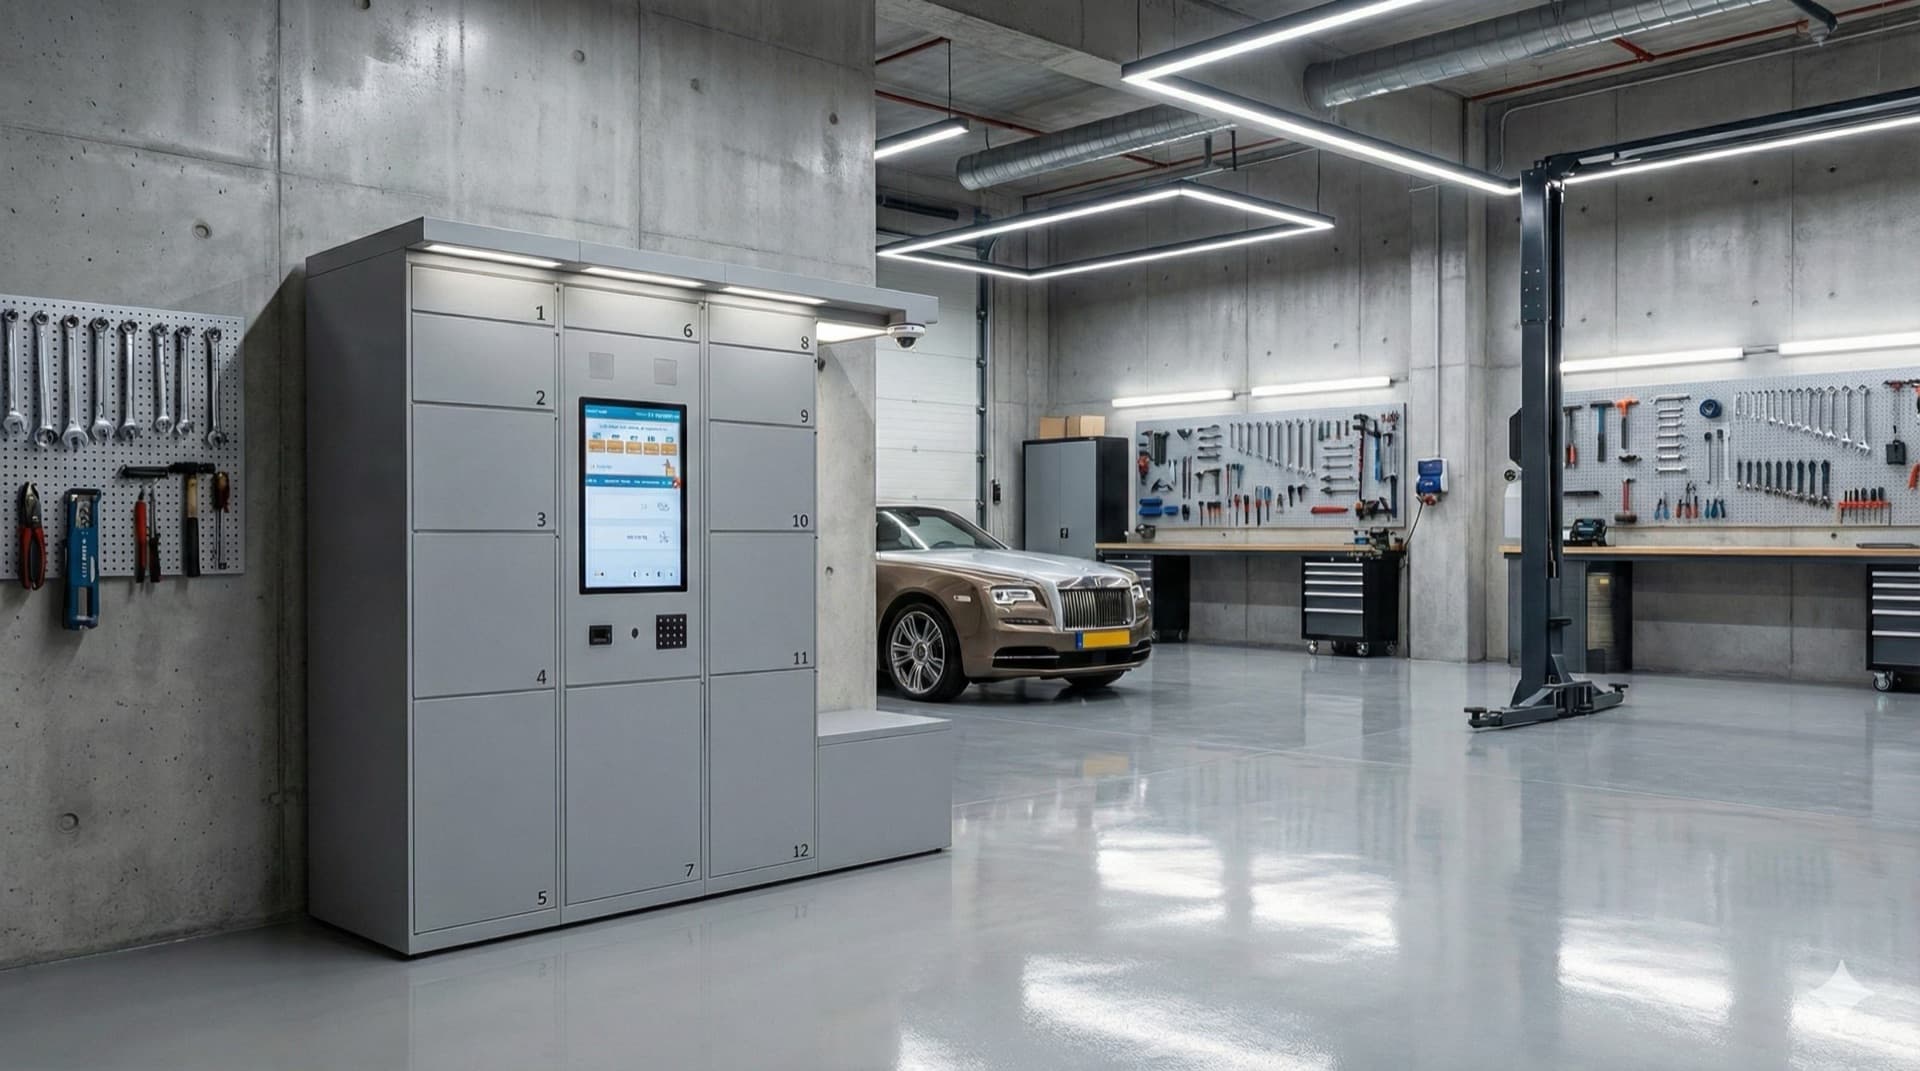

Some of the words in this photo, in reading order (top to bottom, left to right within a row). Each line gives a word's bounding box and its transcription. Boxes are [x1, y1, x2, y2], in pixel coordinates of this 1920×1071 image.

[536, 305, 546, 320] 1
[683, 323, 693, 338] 6
[800, 336, 809, 350] 8
[536, 391, 546, 405] 2
[800, 410, 809, 424] 9
[537, 512, 547, 527] 3
[793, 514, 809, 528] 10
[794, 651, 808, 665] 11
[536, 669, 546, 685] 4
[793, 844, 809, 858] 12
[685, 863, 694, 877] 7
[537, 891, 547, 906] 5
